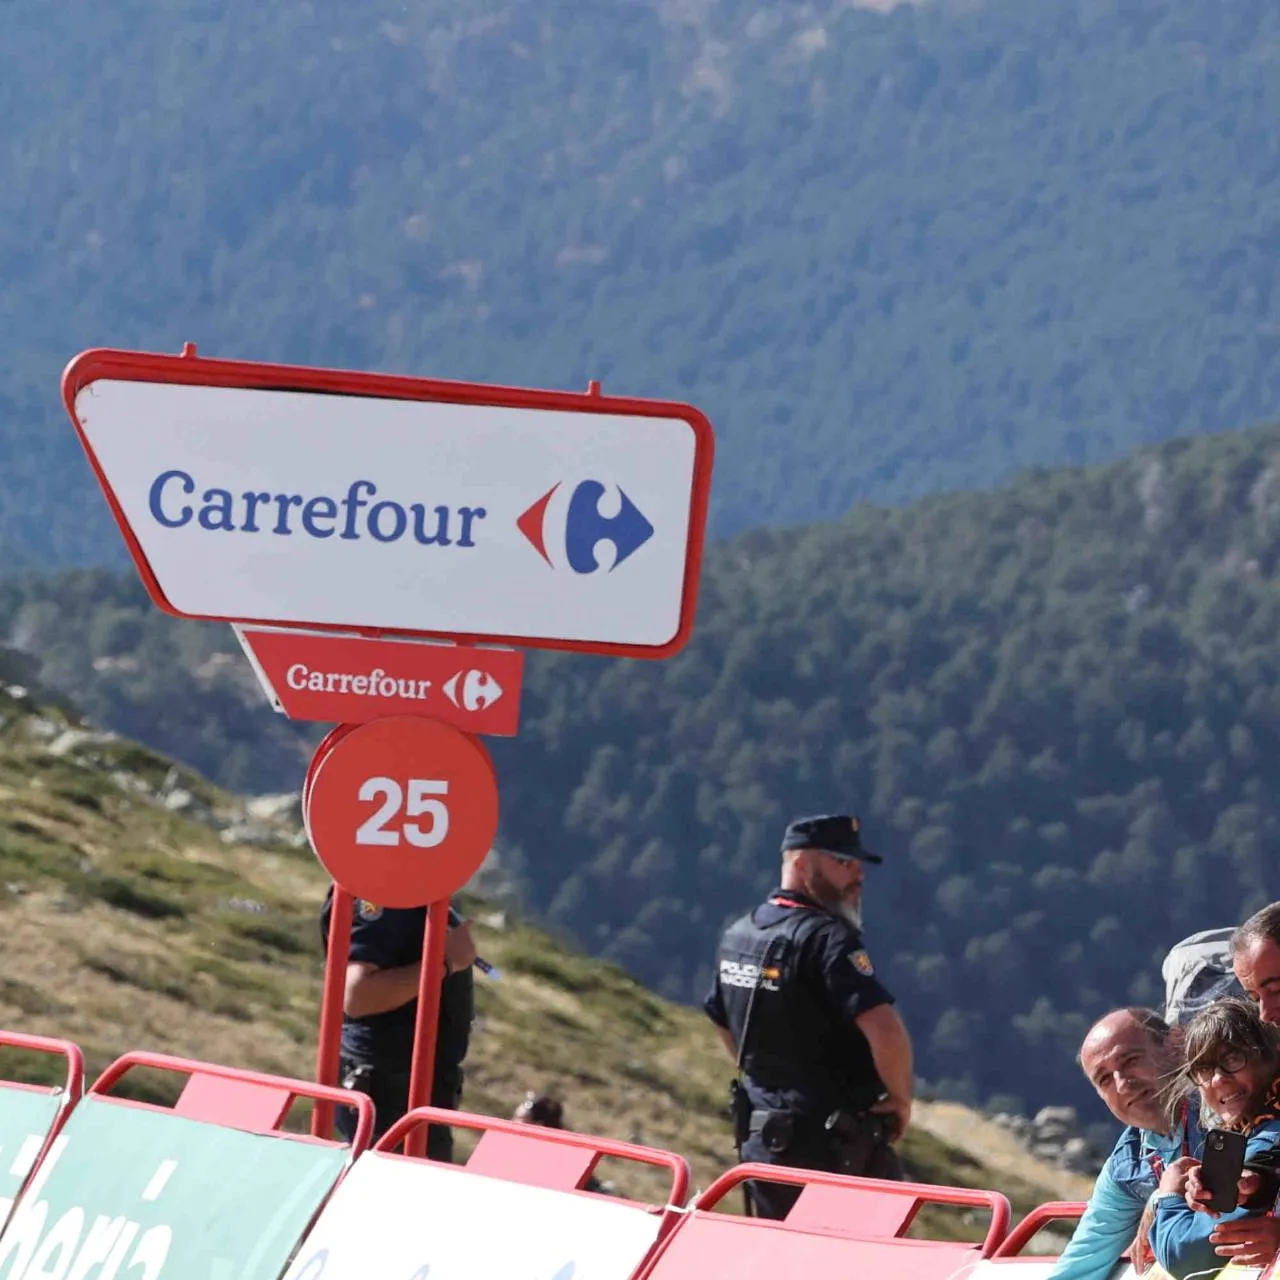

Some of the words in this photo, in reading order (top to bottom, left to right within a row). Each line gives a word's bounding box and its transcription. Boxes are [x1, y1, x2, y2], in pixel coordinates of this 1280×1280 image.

[148, 470, 486, 548] Carrefour
[286, 664, 431, 701] Carrefour
[355, 777, 450, 848] 25
